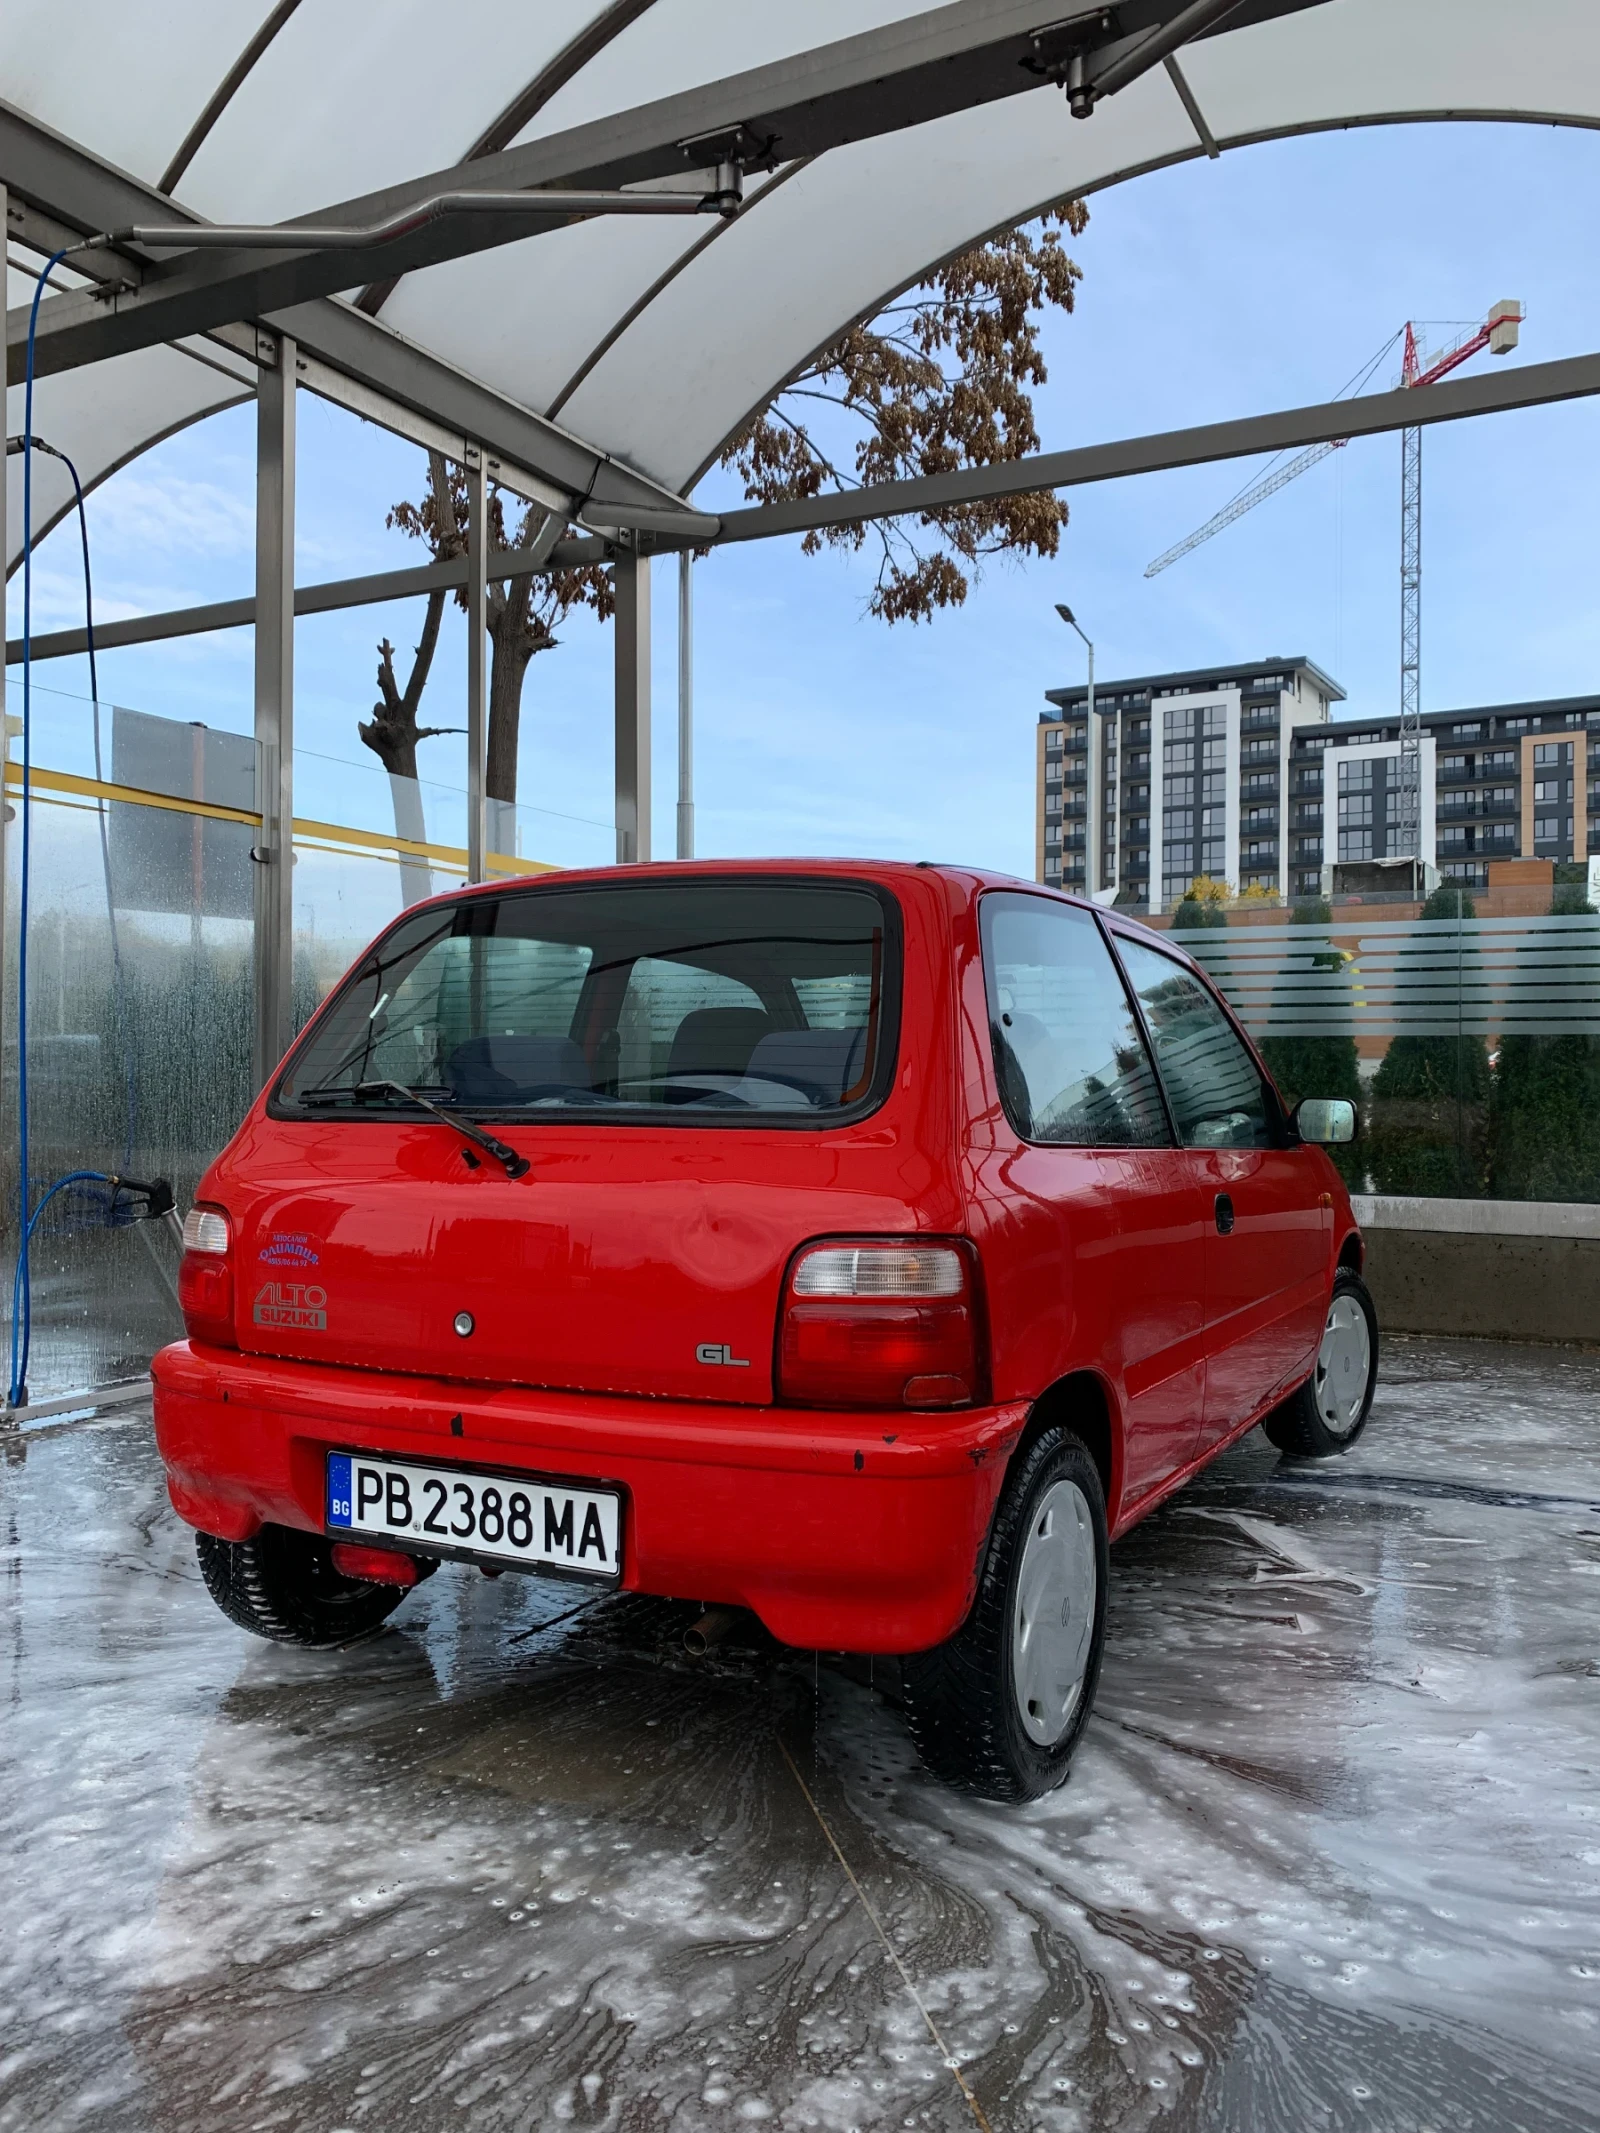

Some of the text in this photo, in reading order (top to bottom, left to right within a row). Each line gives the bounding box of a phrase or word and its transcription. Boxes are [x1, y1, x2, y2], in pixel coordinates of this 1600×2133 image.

[254, 1282, 327, 1309] ALTO
[260, 1308, 319, 1327] SUZUKI
[696, 1343, 750, 1367] GL
[332, 1499, 350, 1517] BG
